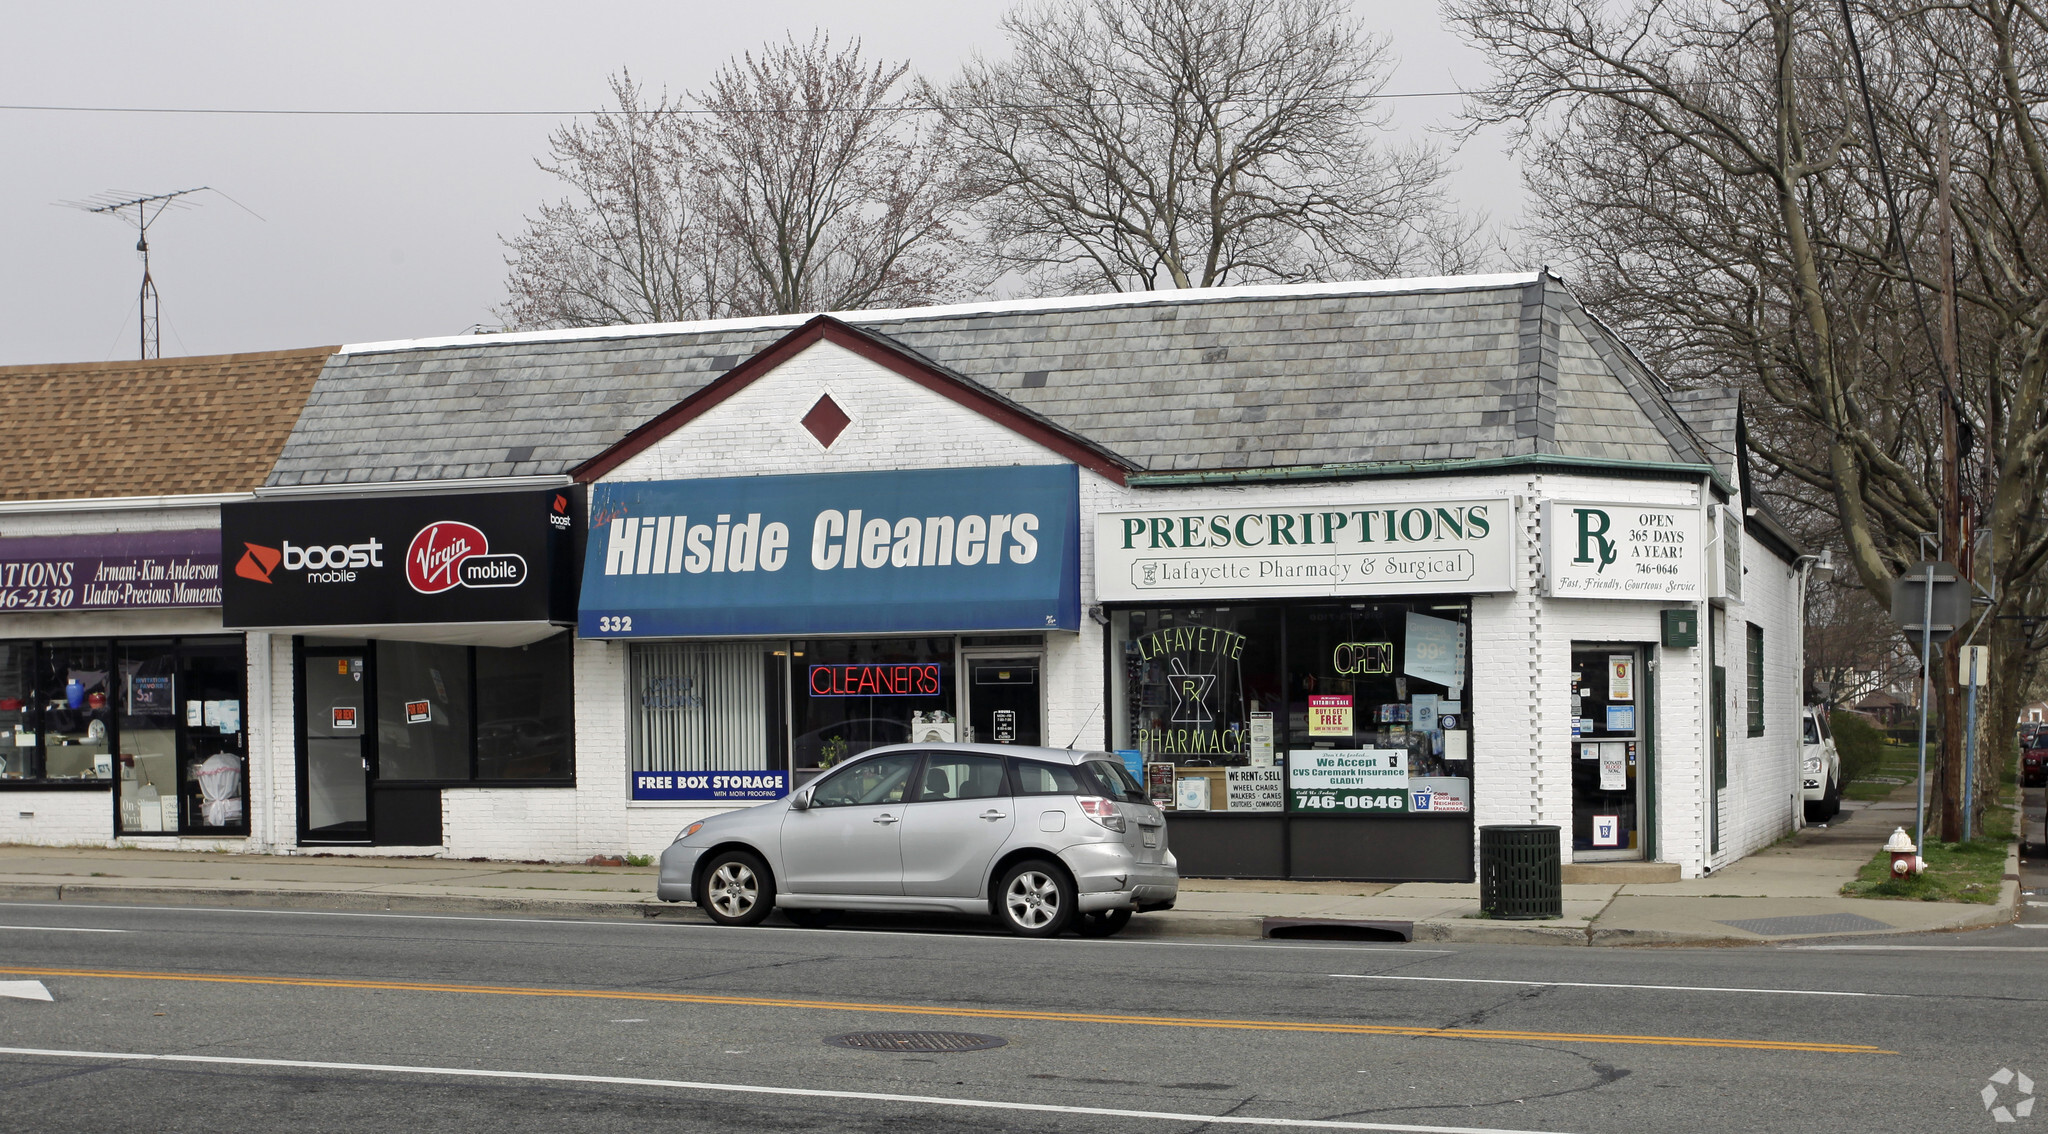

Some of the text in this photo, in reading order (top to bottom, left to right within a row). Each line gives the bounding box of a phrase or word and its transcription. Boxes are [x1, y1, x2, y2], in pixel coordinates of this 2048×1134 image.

[550, 513, 571, 526] boost
[1639, 514, 1674, 527] OPEN
[1120, 505, 1491, 550] PRESCRIPTIONS
[605, 509, 1039, 576] Hillside Cleaners
[1629, 529, 1684, 543] 365 DAYS
[282, 537, 384, 570] boost
[417, 527, 471, 584] Virgin
[1631, 545, 1683, 559] A YEAR!
[0, 561, 75, 588] TIONS
[166, 558, 219, 581] Anderson
[308, 569, 356, 583] mobile
[468, 561, 517, 579] mobile
[1162, 555, 1463, 585] Lafayette Pharmacy & Surgical
[1635, 563, 1679, 575] 746-0646
[1558, 577, 1696, 593] Fast, Friendly, Courteous Service
[172, 582, 223, 604] Moments
[599, 615, 632, 632] 332
[1137, 627, 1246, 661] LAFAYETTE
[1334, 643, 1393, 674] OPEN
[811, 665, 938, 694] CLEANERS
[1320, 715, 1343, 725] FREE
[1138, 729, 1246, 754] PHARMACY
[1316, 758, 1377, 768] We Accept
[1228, 771, 1239, 781] WE
[1241, 771, 1258, 781] RENT
[1264, 771, 1281, 781] SELL
[1312, 768, 1356, 776] Caremark
[1357, 768, 1405, 776] Insurance
[638, 775, 783, 789] FREE BOX STORAGE
[1330, 777, 1364, 785] GLADLY!
[1230, 792, 1256, 800] WALKERS
[1296, 796, 1403, 809] 746-0646
